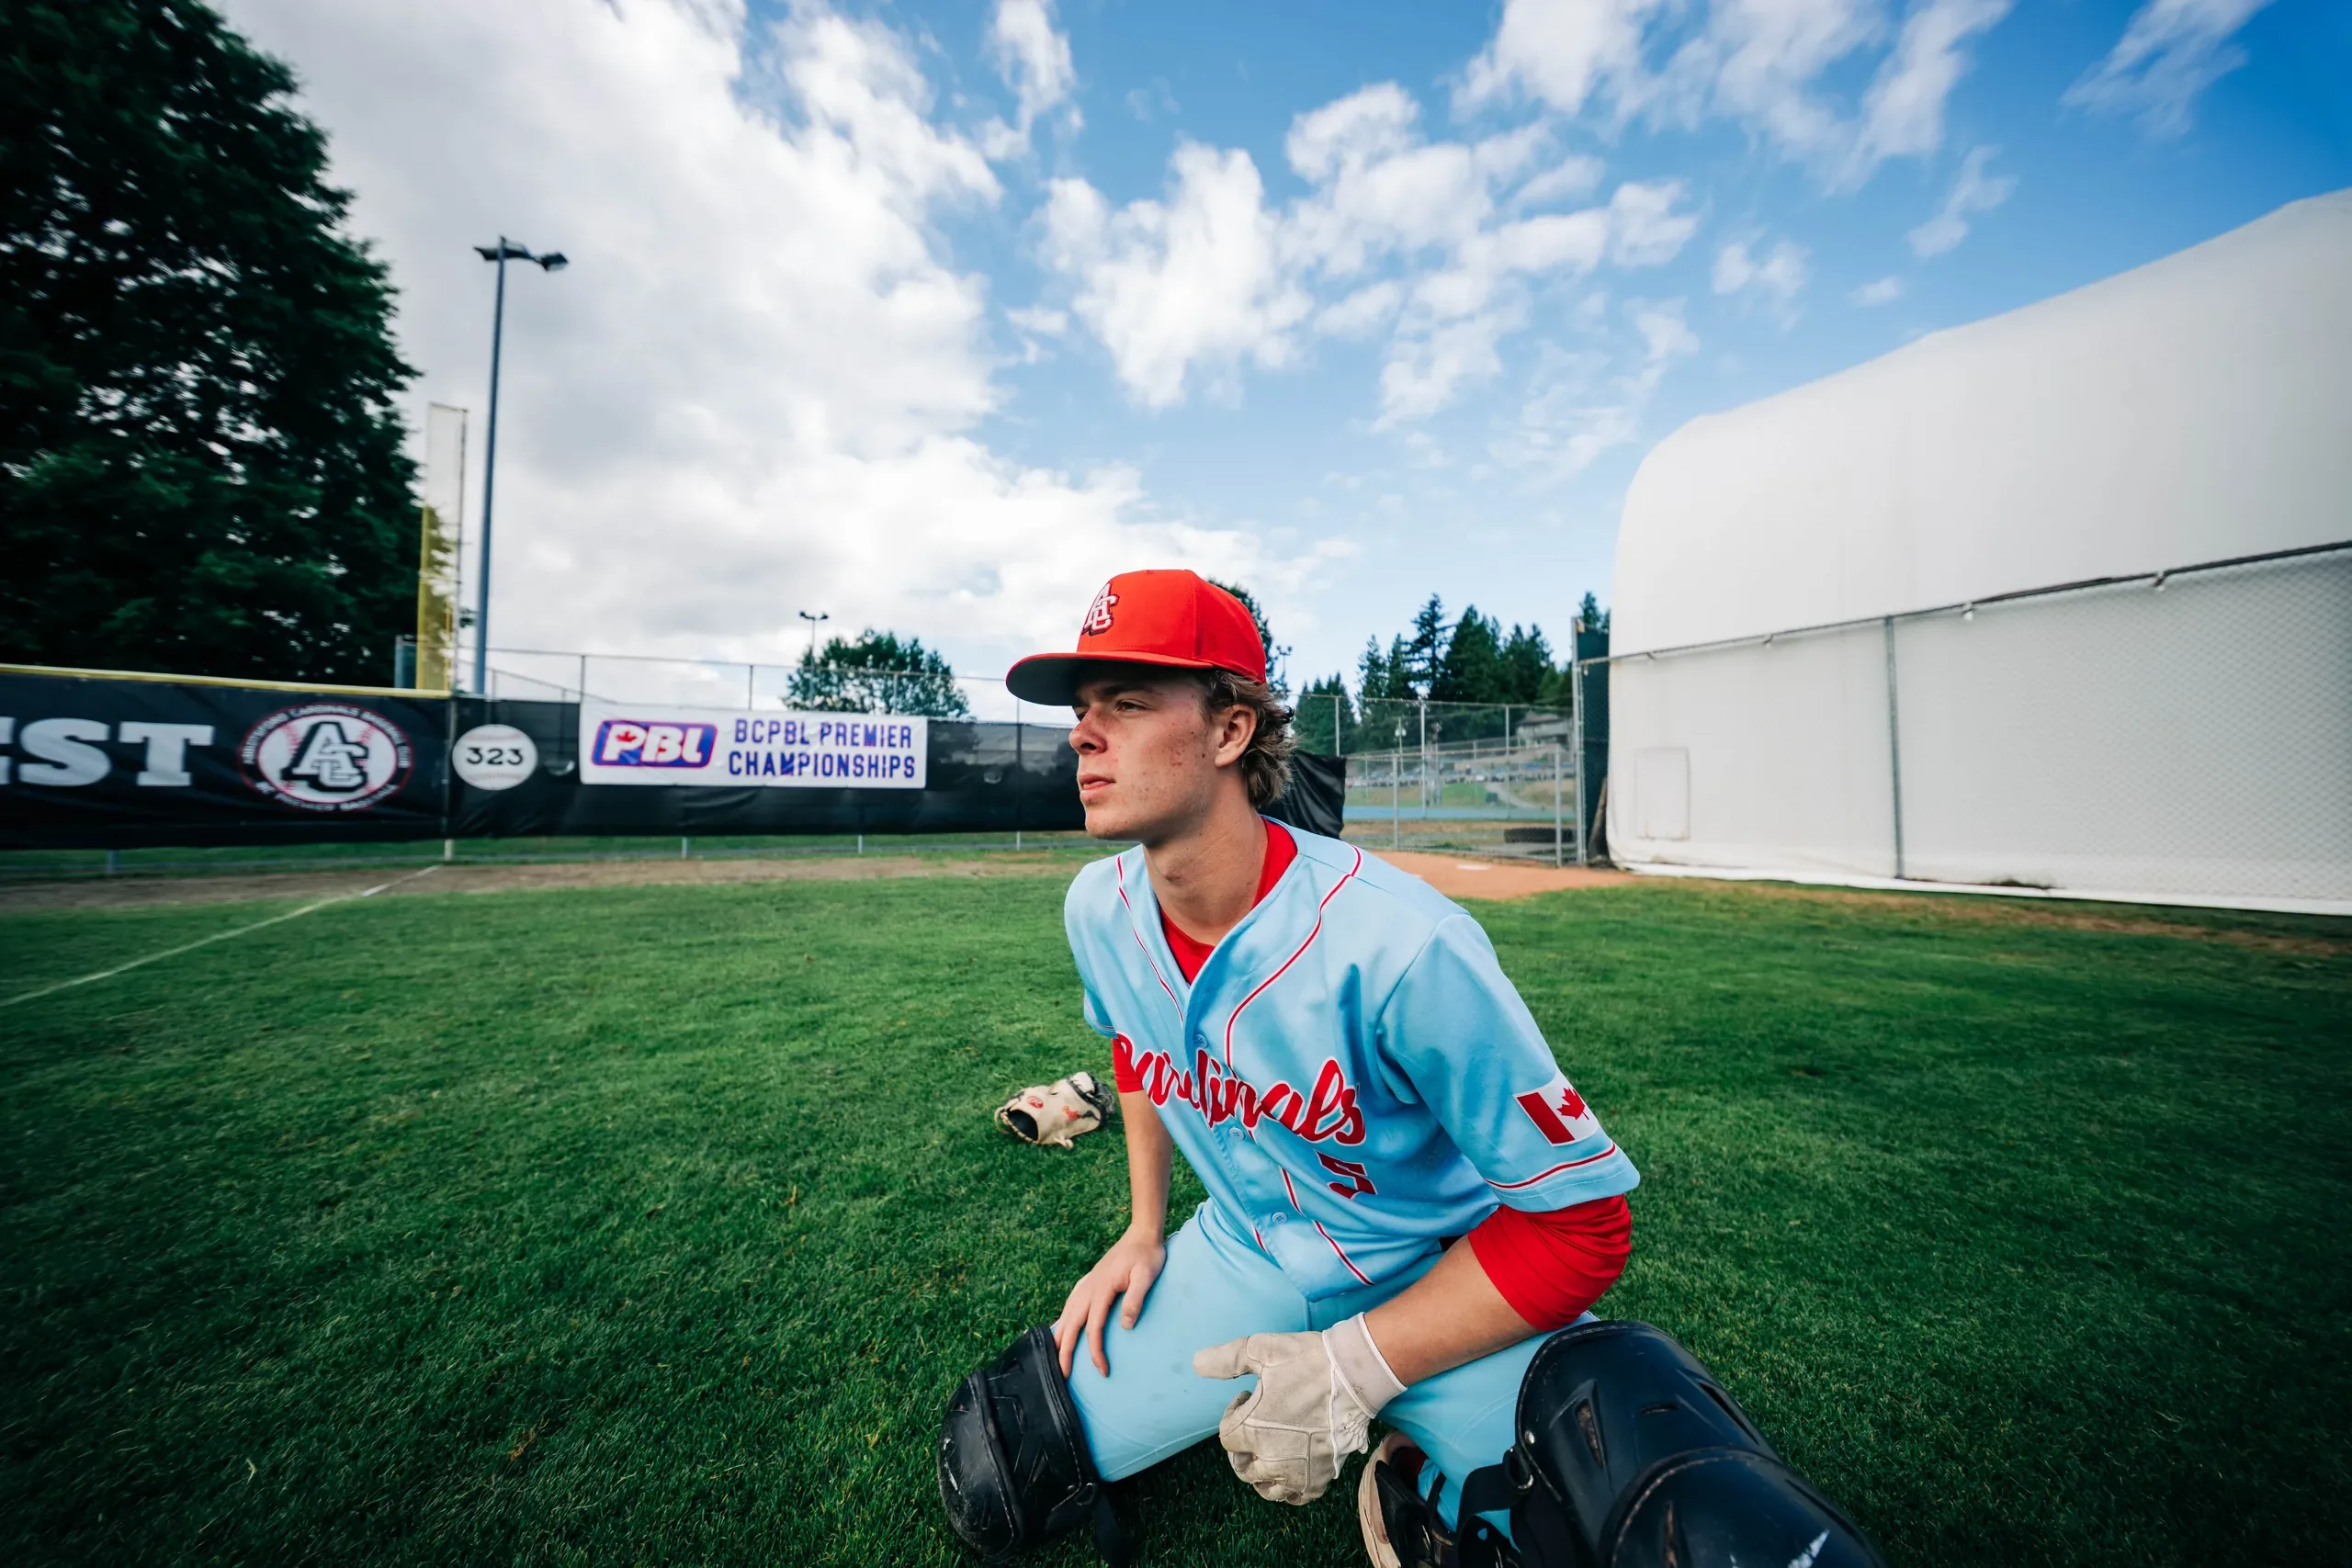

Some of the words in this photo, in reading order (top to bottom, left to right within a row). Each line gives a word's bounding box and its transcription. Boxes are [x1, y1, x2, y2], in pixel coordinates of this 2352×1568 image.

[600, 722, 704, 764] PBL
[734, 717, 810, 747] BCPBL
[820, 721, 911, 749] PREMIER
[0, 715, 215, 787] ST
[466, 747, 524, 765] 323
[728, 750, 915, 779] CHAMPIONSHIPS
